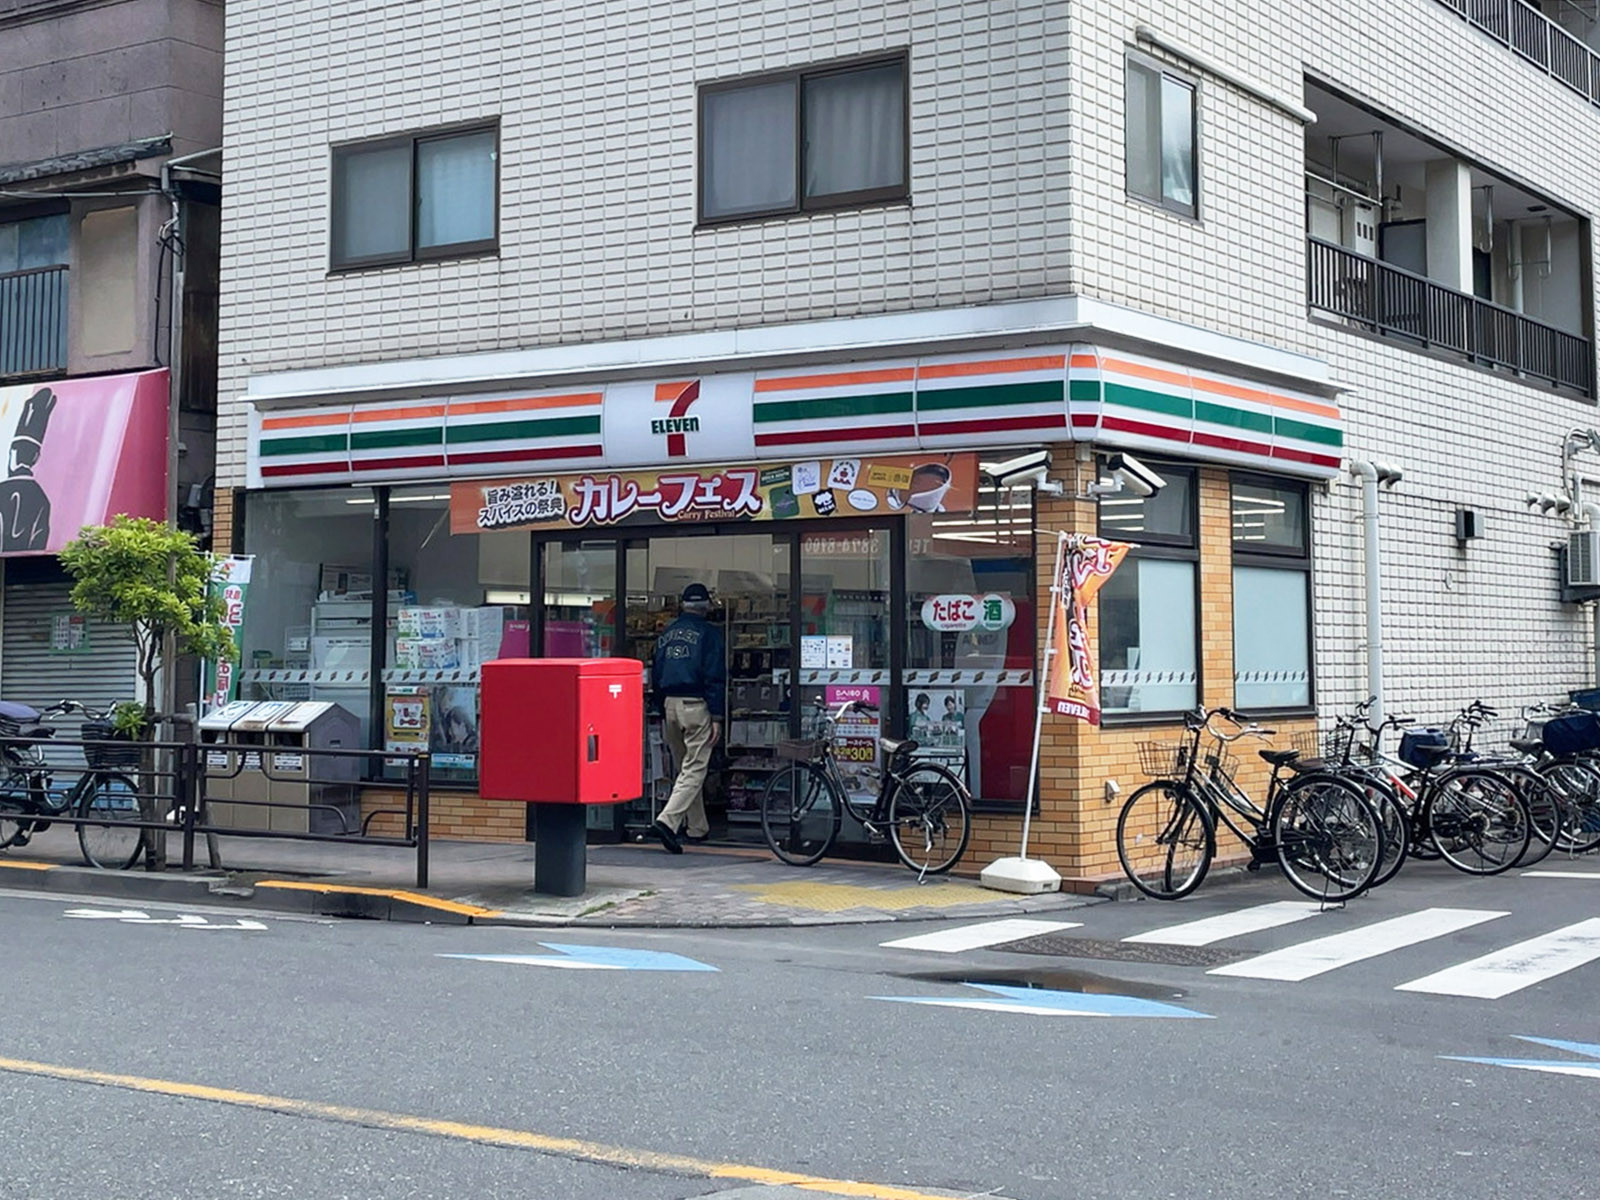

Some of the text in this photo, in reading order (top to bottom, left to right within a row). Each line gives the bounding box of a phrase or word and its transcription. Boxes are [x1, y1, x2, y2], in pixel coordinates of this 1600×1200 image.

[655, 380, 700, 457] 7
[480, 497, 562, 523] スパイスの祭典
[570, 471, 762, 523] カレーフェス
[678, 509, 735, 521] Curry Festival
[933, 600, 1002, 621] たばこ 酒
